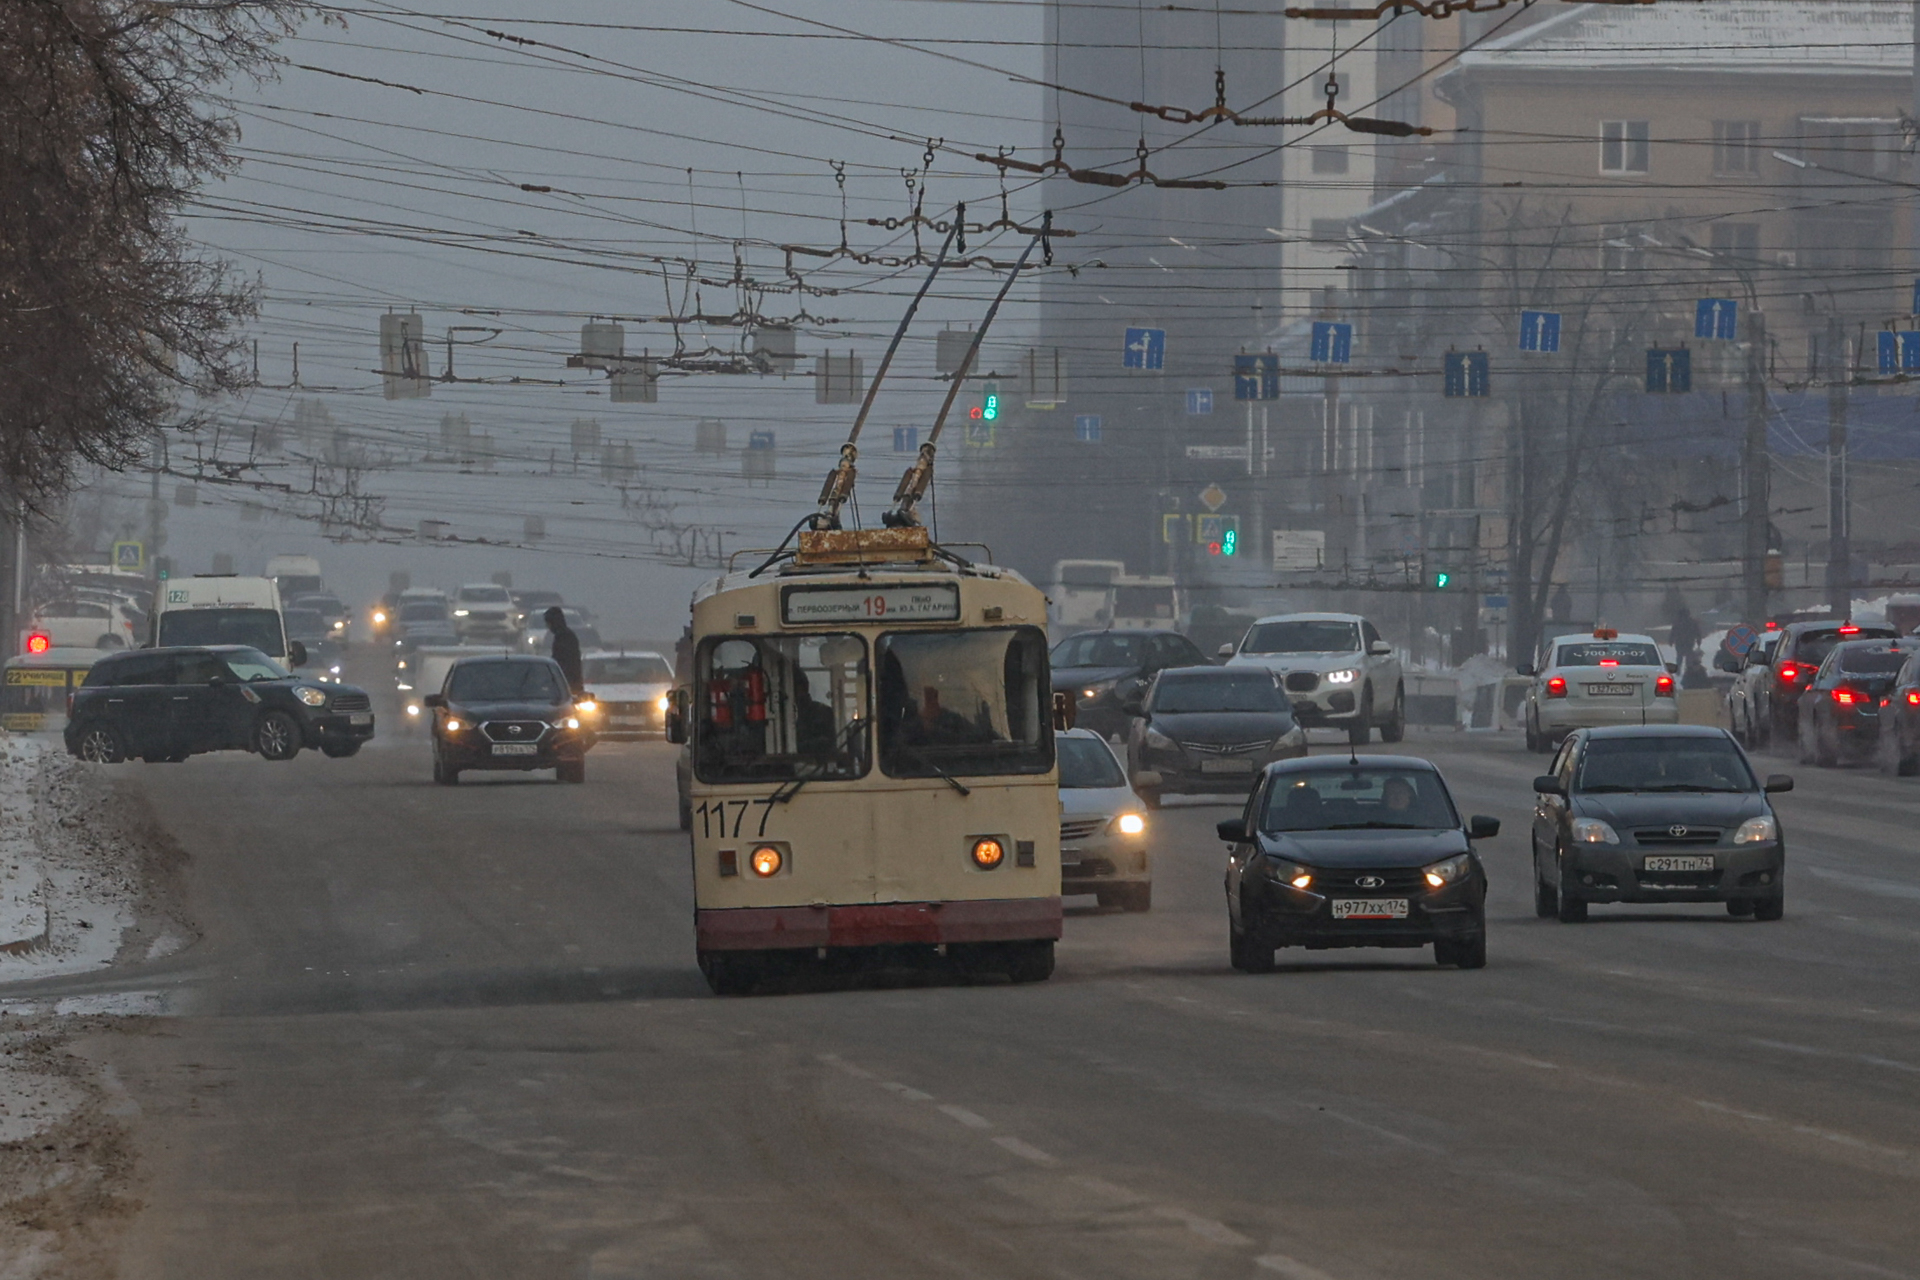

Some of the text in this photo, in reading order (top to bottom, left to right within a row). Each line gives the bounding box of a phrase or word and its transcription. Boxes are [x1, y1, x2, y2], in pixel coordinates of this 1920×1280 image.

[863, 595, 886, 616] 19
[8, 672, 22, 684] 22
[696, 799, 776, 839] 1177
